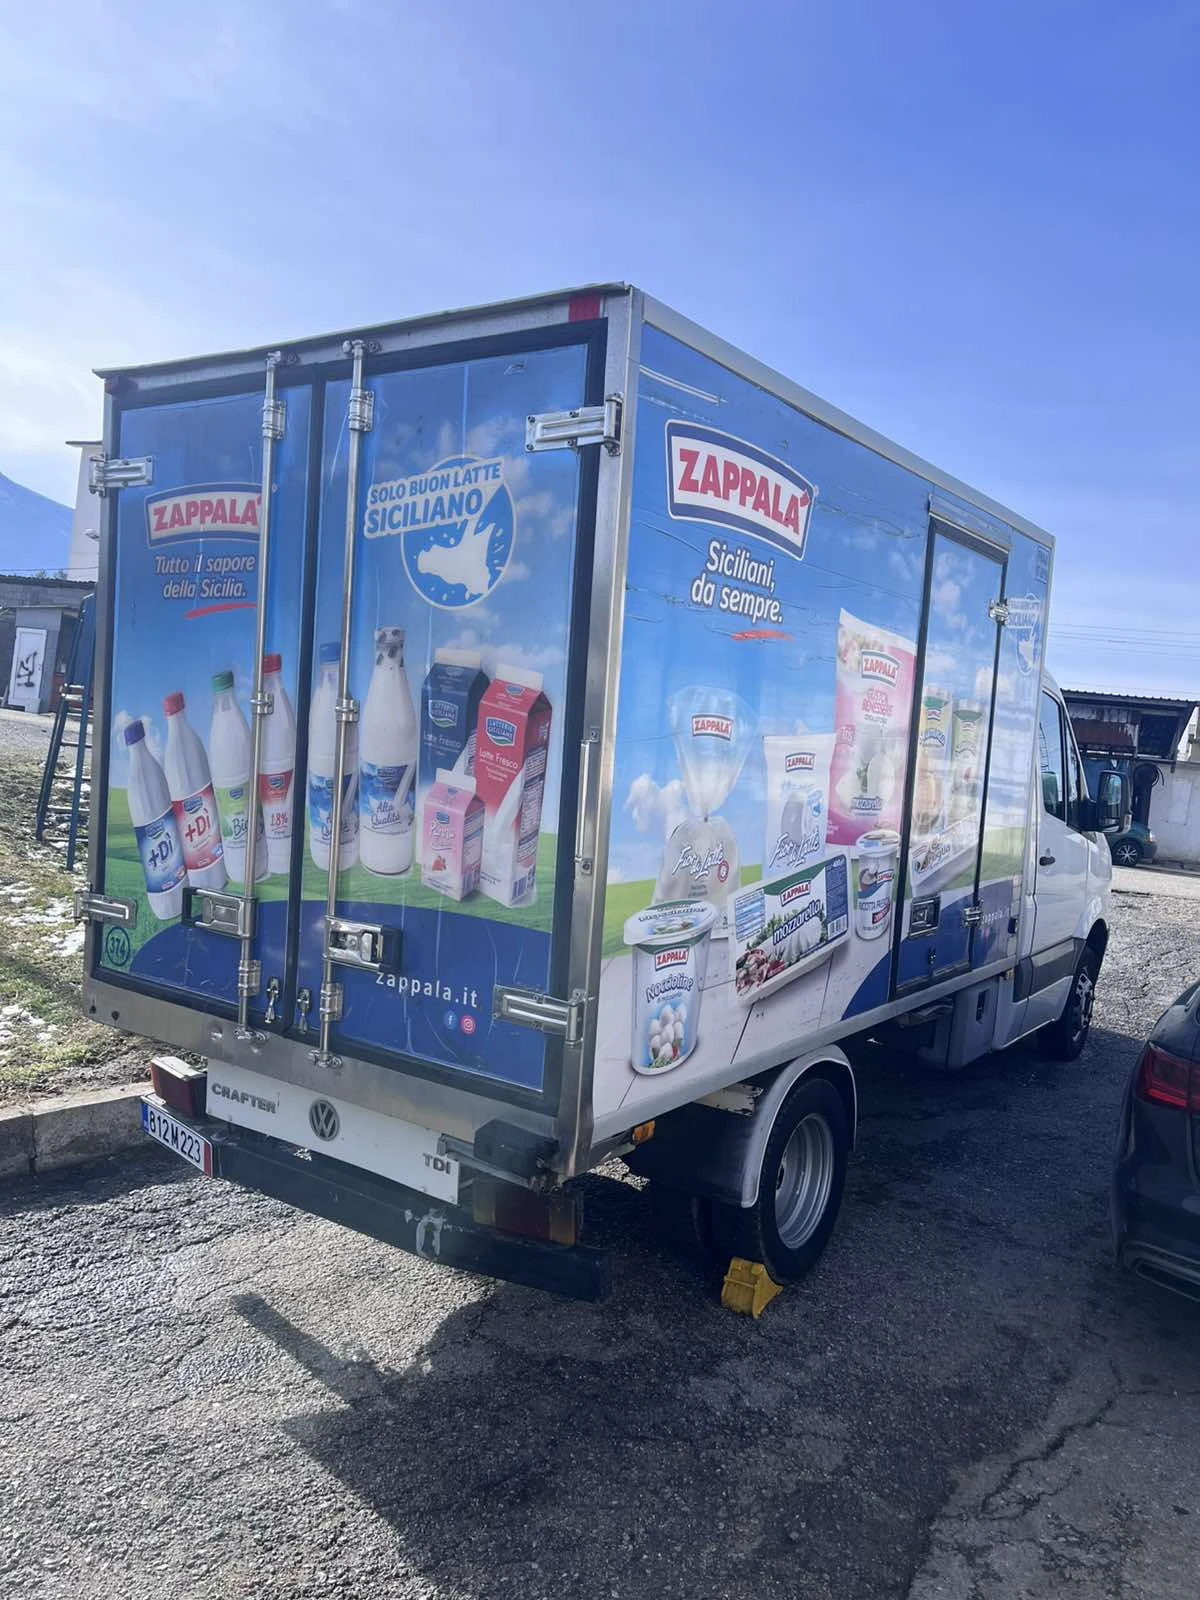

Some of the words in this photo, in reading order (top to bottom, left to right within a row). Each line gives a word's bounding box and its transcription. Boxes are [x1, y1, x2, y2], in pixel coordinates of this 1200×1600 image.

[370, 484, 406, 505] SOLO
[408, 473, 450, 496] BUON
[453, 462, 501, 488] LATTE
[366, 487, 484, 534] SICILIANO
[155, 555, 190, 574] Tutto
[193, 553, 203, 574] il
[206, 555, 257, 577] sapore
[706, 540, 776, 592] Siciliani,
[163, 579, 197, 598] della
[200, 578, 247, 598] Sicilia.
[691, 573, 716, 606] da
[719, 586, 784, 624] sempre.
[439, 734, 462, 749] Fresco
[480, 747, 495, 761] Latte
[496, 751, 519, 769] Fresco
[773, 899, 821, 945] mozzarella
[109, 936, 126, 958] 374
[375, 970, 478, 1008] zappala.it
[211, 1082, 277, 1115] CRAFTER
[149, 1107, 202, 1164] 812M223
[422, 1152, 451, 1175] TDI
